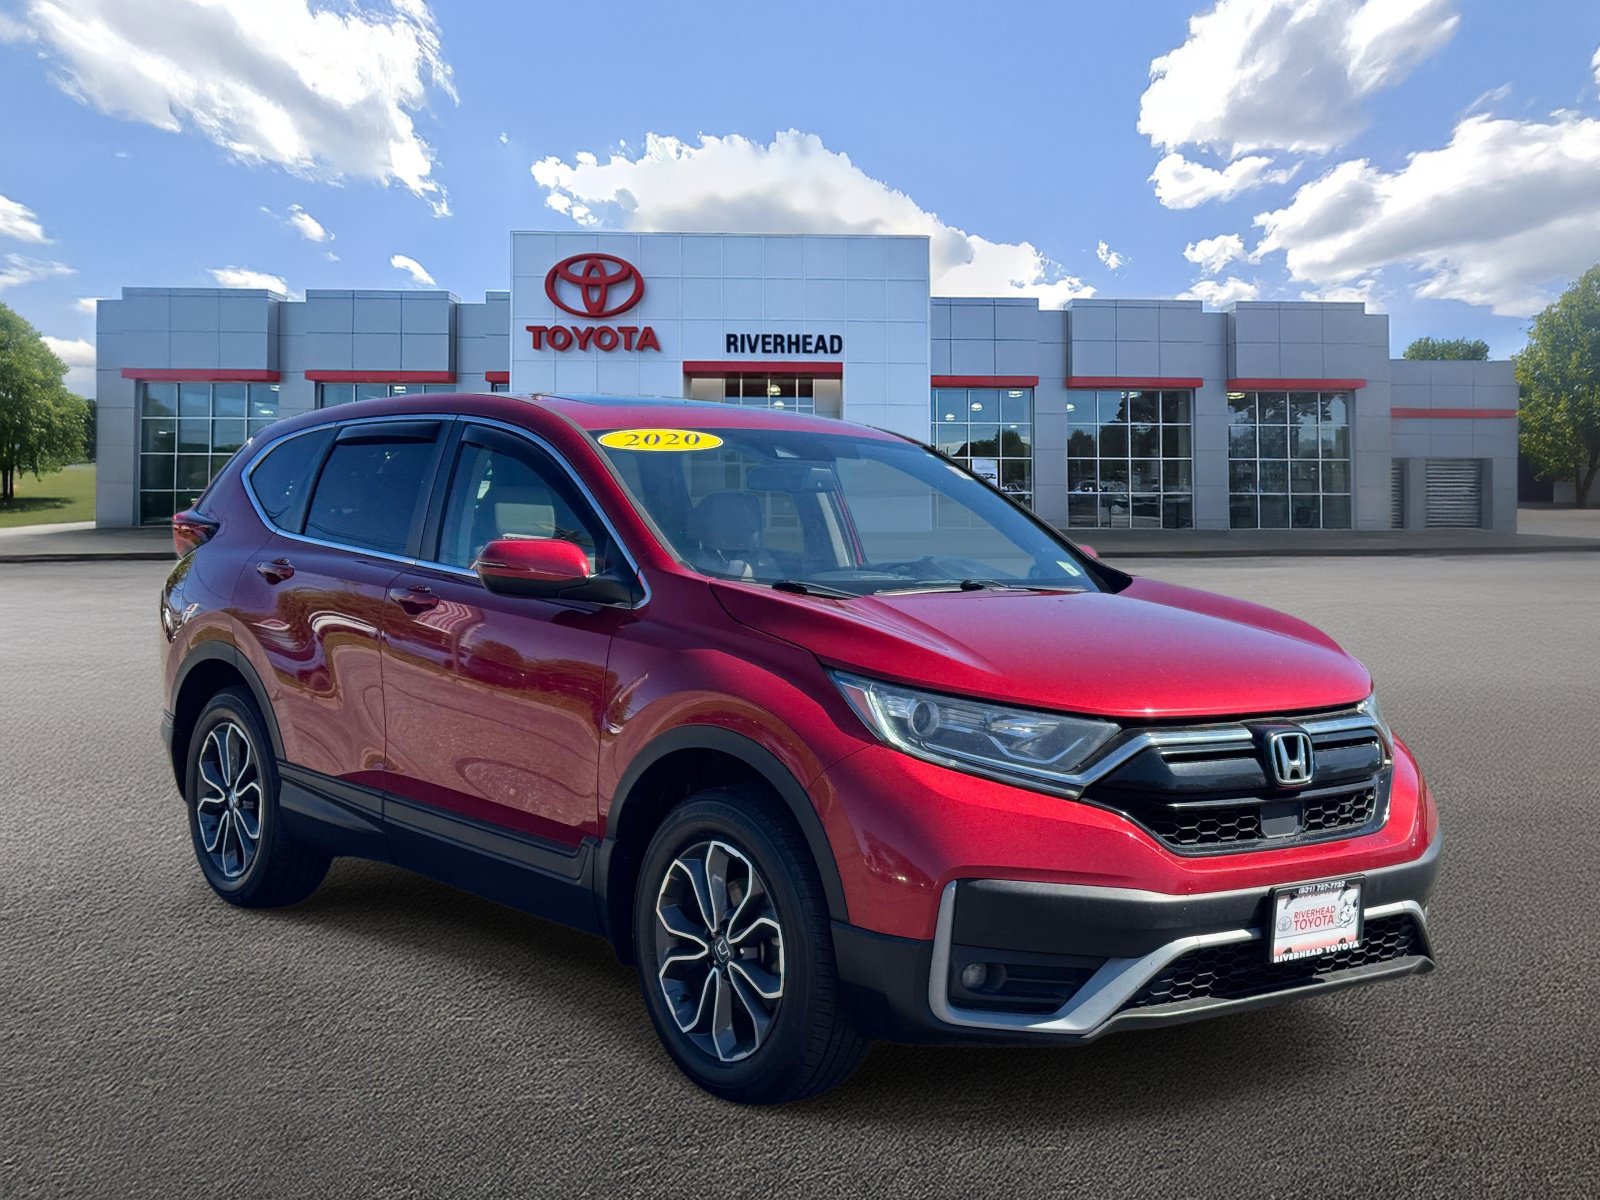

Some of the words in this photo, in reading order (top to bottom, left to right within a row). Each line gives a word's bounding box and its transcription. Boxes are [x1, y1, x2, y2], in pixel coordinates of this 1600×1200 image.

[525, 325, 661, 351] TOYOTA
[726, 333, 843, 354] RIVERHEAD
[624, 433, 701, 447] 2020
[1294, 905, 1336, 919] RIVERHEAD
[1294, 914, 1334, 930] TOYOTA
[1274, 947, 1323, 963] RIVERHEAD
[1325, 941, 1360, 953] TOYOTA
